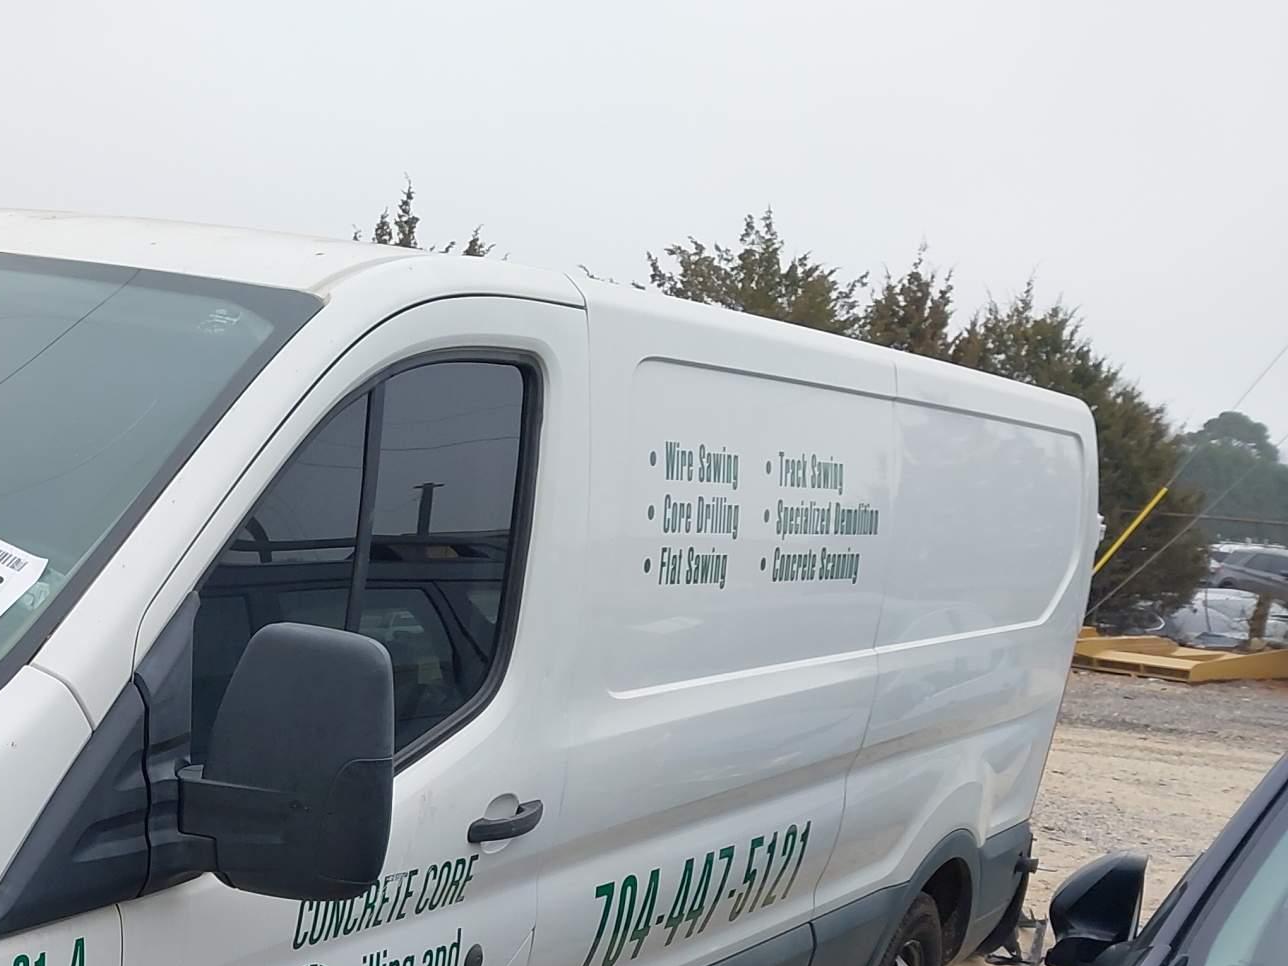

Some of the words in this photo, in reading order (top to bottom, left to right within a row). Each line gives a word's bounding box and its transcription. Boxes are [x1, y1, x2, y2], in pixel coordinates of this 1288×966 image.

[665, 441, 694, 481] Wire
[698, 444, 739, 490] Sawing
[778, 451, 808, 488] Track
[811, 454, 844, 495] Sawing
[663, 494, 692, 534] Core
[696, 496, 740, 540] Drilling
[776, 499, 832, 540] Specialized
[833, 502, 880, 535] Demolition
[659, 547, 683, 585] Flat
[685, 547, 728, 589] Sawing
[772, 547, 817, 582] Concrete
[818, 547, 861, 584] Scanning
[414, 854, 480, 915] CORE
